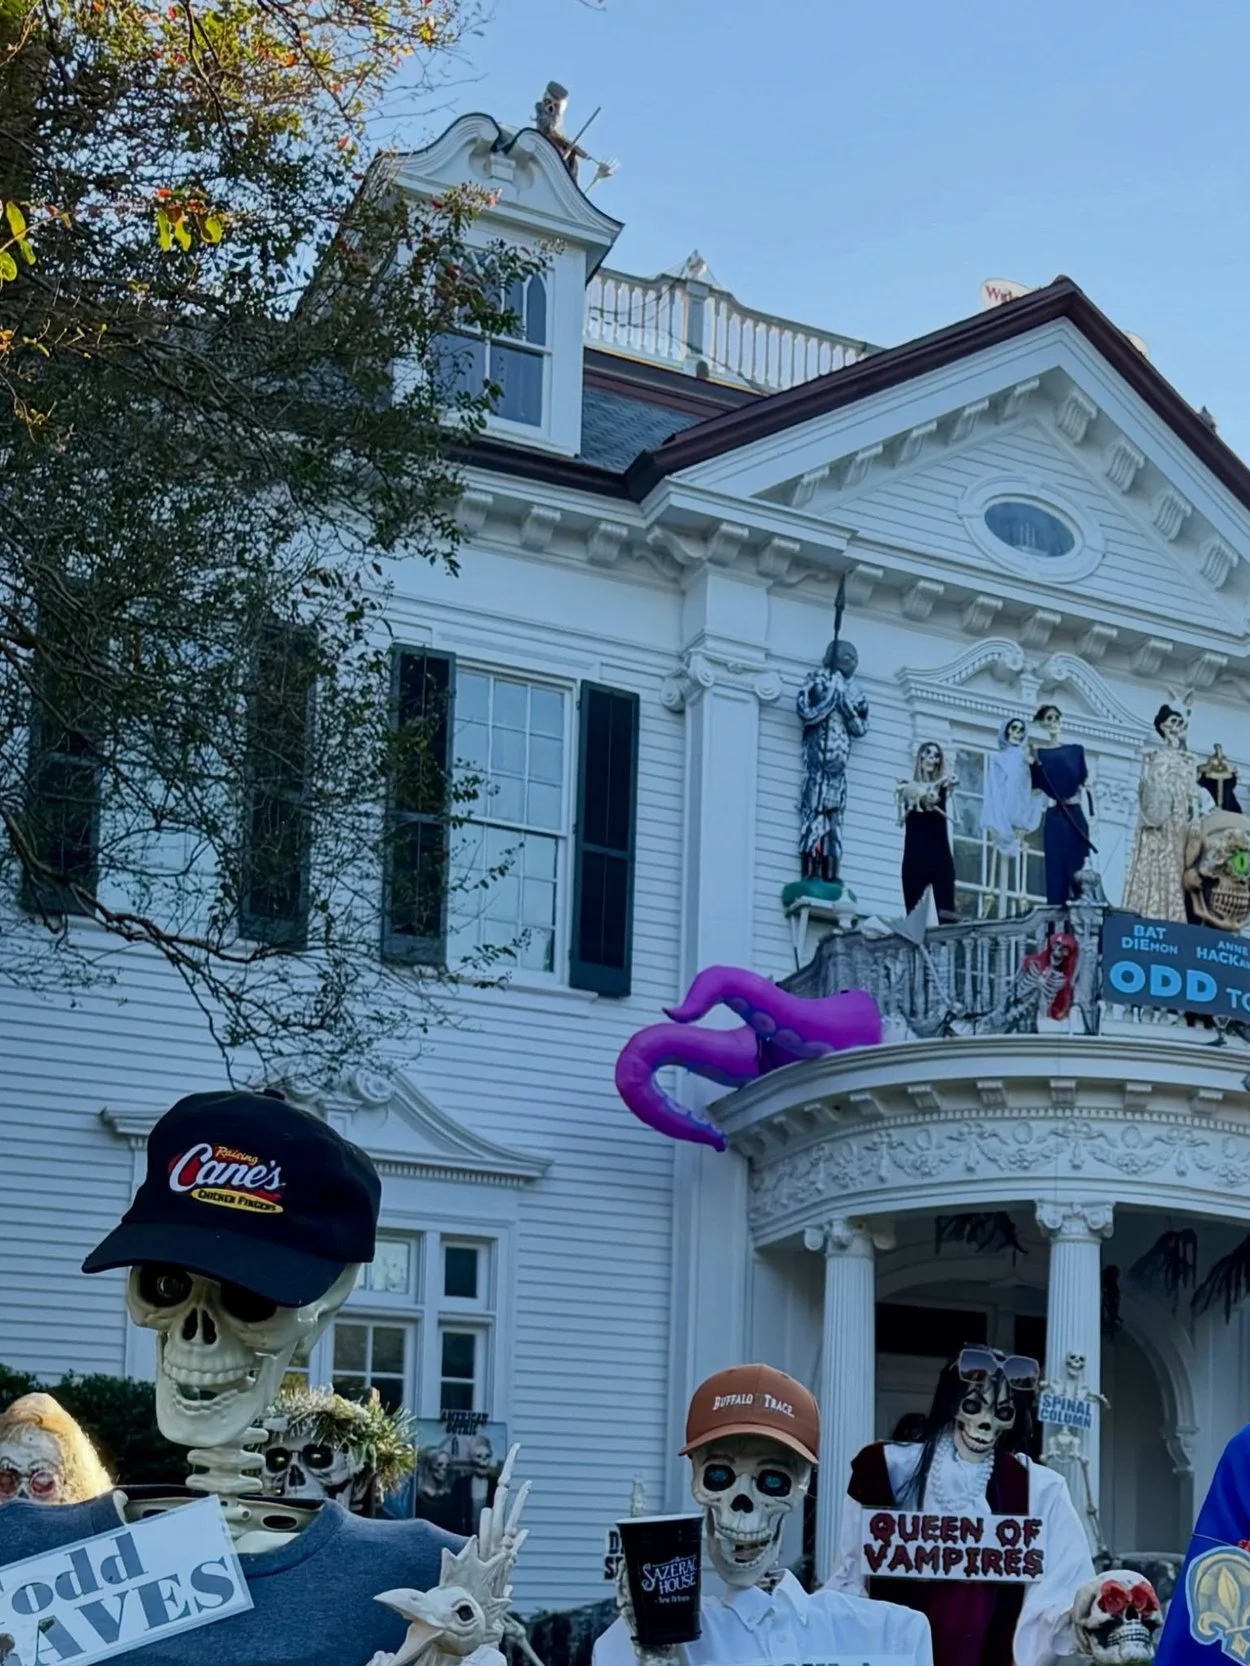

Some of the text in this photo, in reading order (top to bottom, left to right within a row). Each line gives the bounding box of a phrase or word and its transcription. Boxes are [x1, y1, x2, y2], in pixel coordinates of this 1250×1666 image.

[1134, 925, 1166, 939] BAT
[1217, 940, 1249, 956] ANNE
[1110, 961, 1217, 1002] ODD
[169, 1143, 286, 1192] Cane's
[215, 1146, 258, 1165] Raising
[712, 1394, 795, 1418] BUFFALO TRACE
[1043, 1394, 1091, 1416] SPINAL
[1041, 1408, 1091, 1428] COLUMN
[869, 1513, 1042, 1548] QUEEN OF
[864, 1543, 1044, 1578] VAMPIRES
[0, 1531, 149, 1615] odd
[642, 1557, 697, 1592] SAZERAC
[659, 1572, 696, 1595] HOUSE
